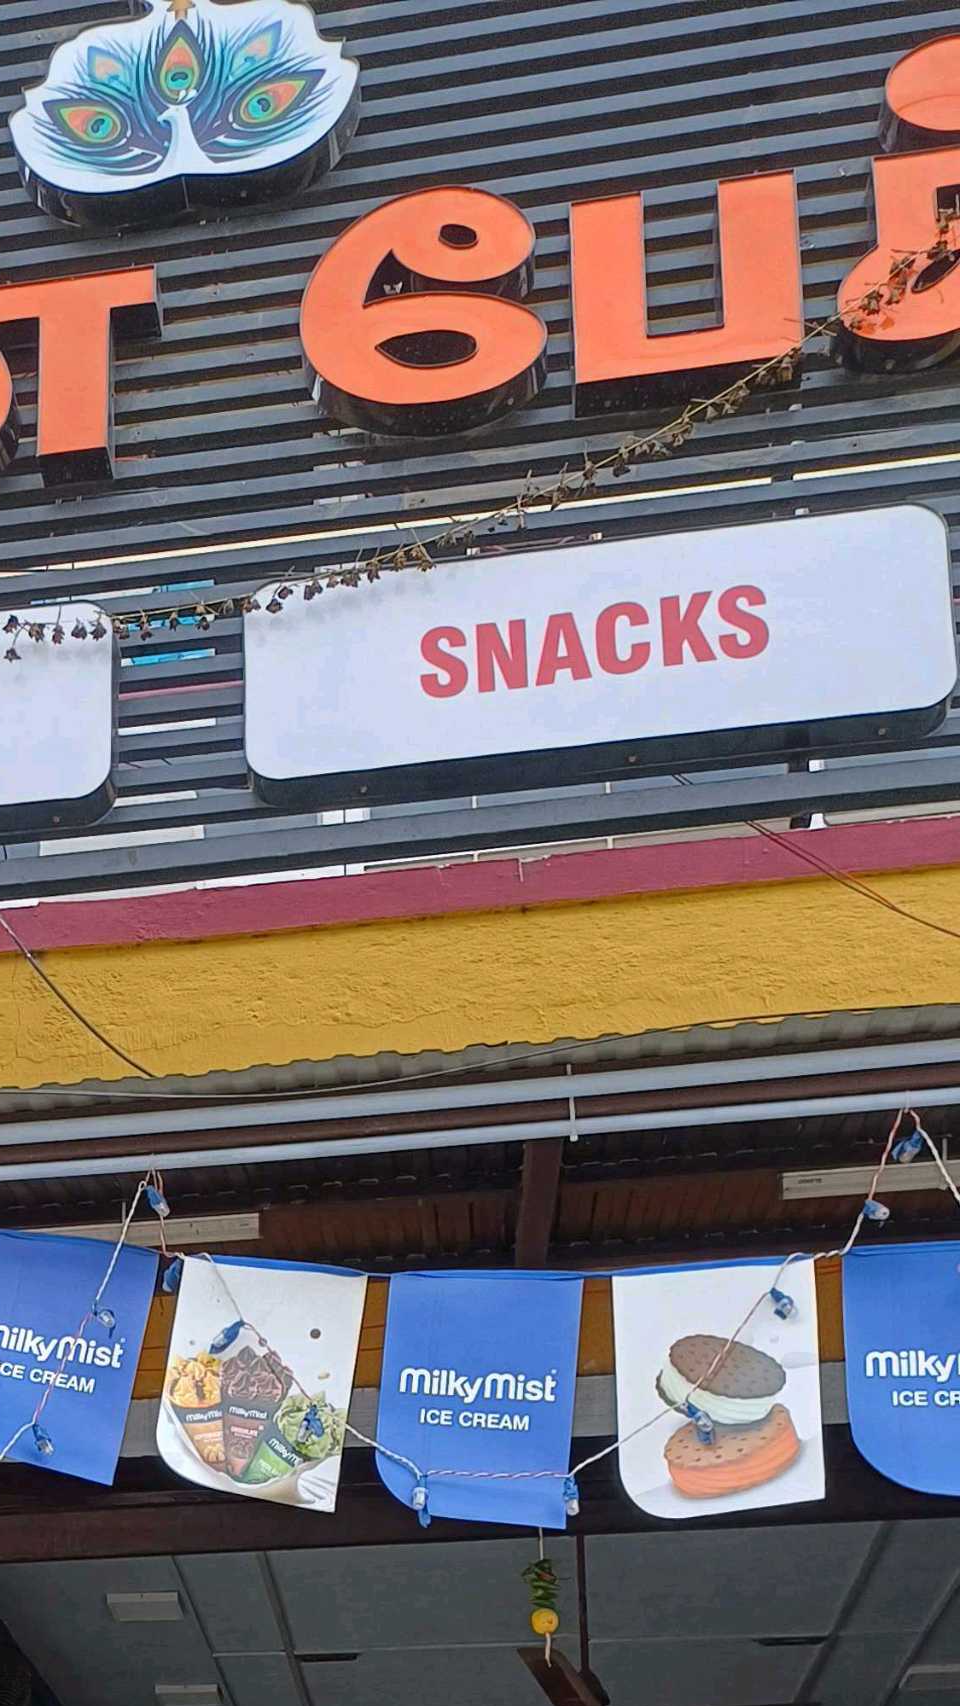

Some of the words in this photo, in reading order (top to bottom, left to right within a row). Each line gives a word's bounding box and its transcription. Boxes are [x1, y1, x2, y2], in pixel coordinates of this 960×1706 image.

[420, 584, 770, 699] SNACKS
[29, 1369, 96, 1393] CREAM
[892, 1390, 929, 1407] ICE
[419, 1408, 453, 1425] ICE
[458, 1411, 530, 1431] CREAM
